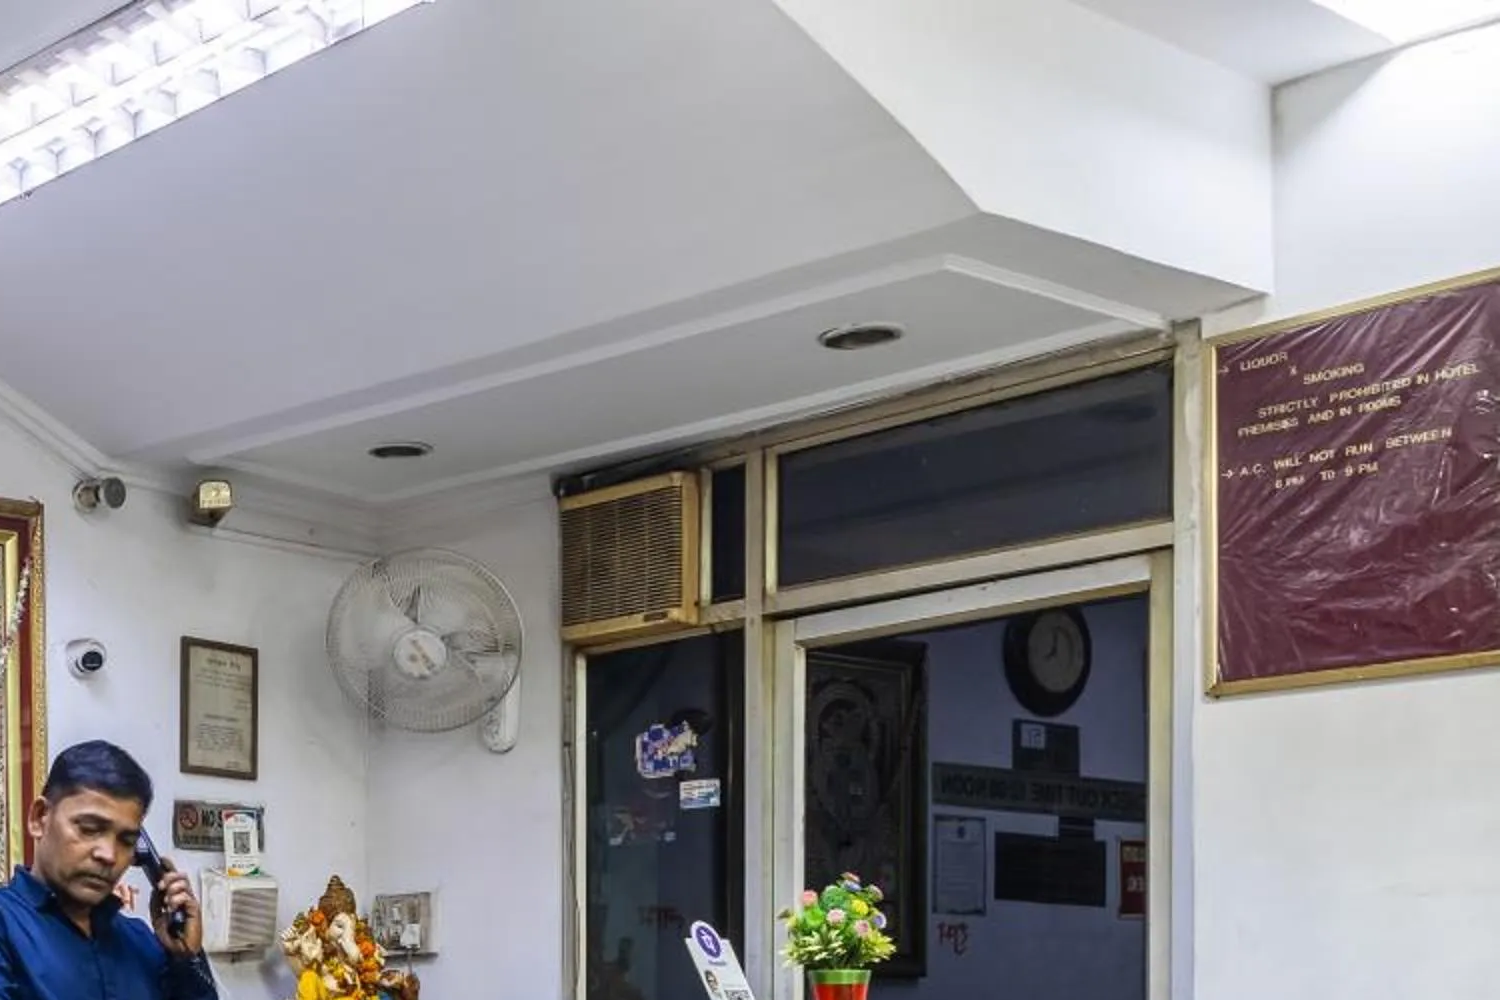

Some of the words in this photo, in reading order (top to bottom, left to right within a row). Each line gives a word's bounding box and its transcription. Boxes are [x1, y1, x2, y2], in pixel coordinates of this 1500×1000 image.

[1240, 351, 1288, 371] LIQUOR
[1303, 362, 1365, 385] SMOKING
[1258, 396, 1319, 419] STRICTLY
[1329, 376, 1412, 403] PROHIBITED
[1416, 372, 1430, 385] IN
[1435, 362, 1480, 380] HOTEL
[1307, 408, 1335, 425] AND
[1339, 405, 1353, 417] IN
[1273, 456, 1303, 472] WILL
[1309, 449, 1336, 464] NOT
[1345, 442, 1374, 457] RUN
[1385, 426, 1453, 450] BETWEEN
[1319, 469, 1336, 482] TO
[1357, 460, 1380, 475] PM
